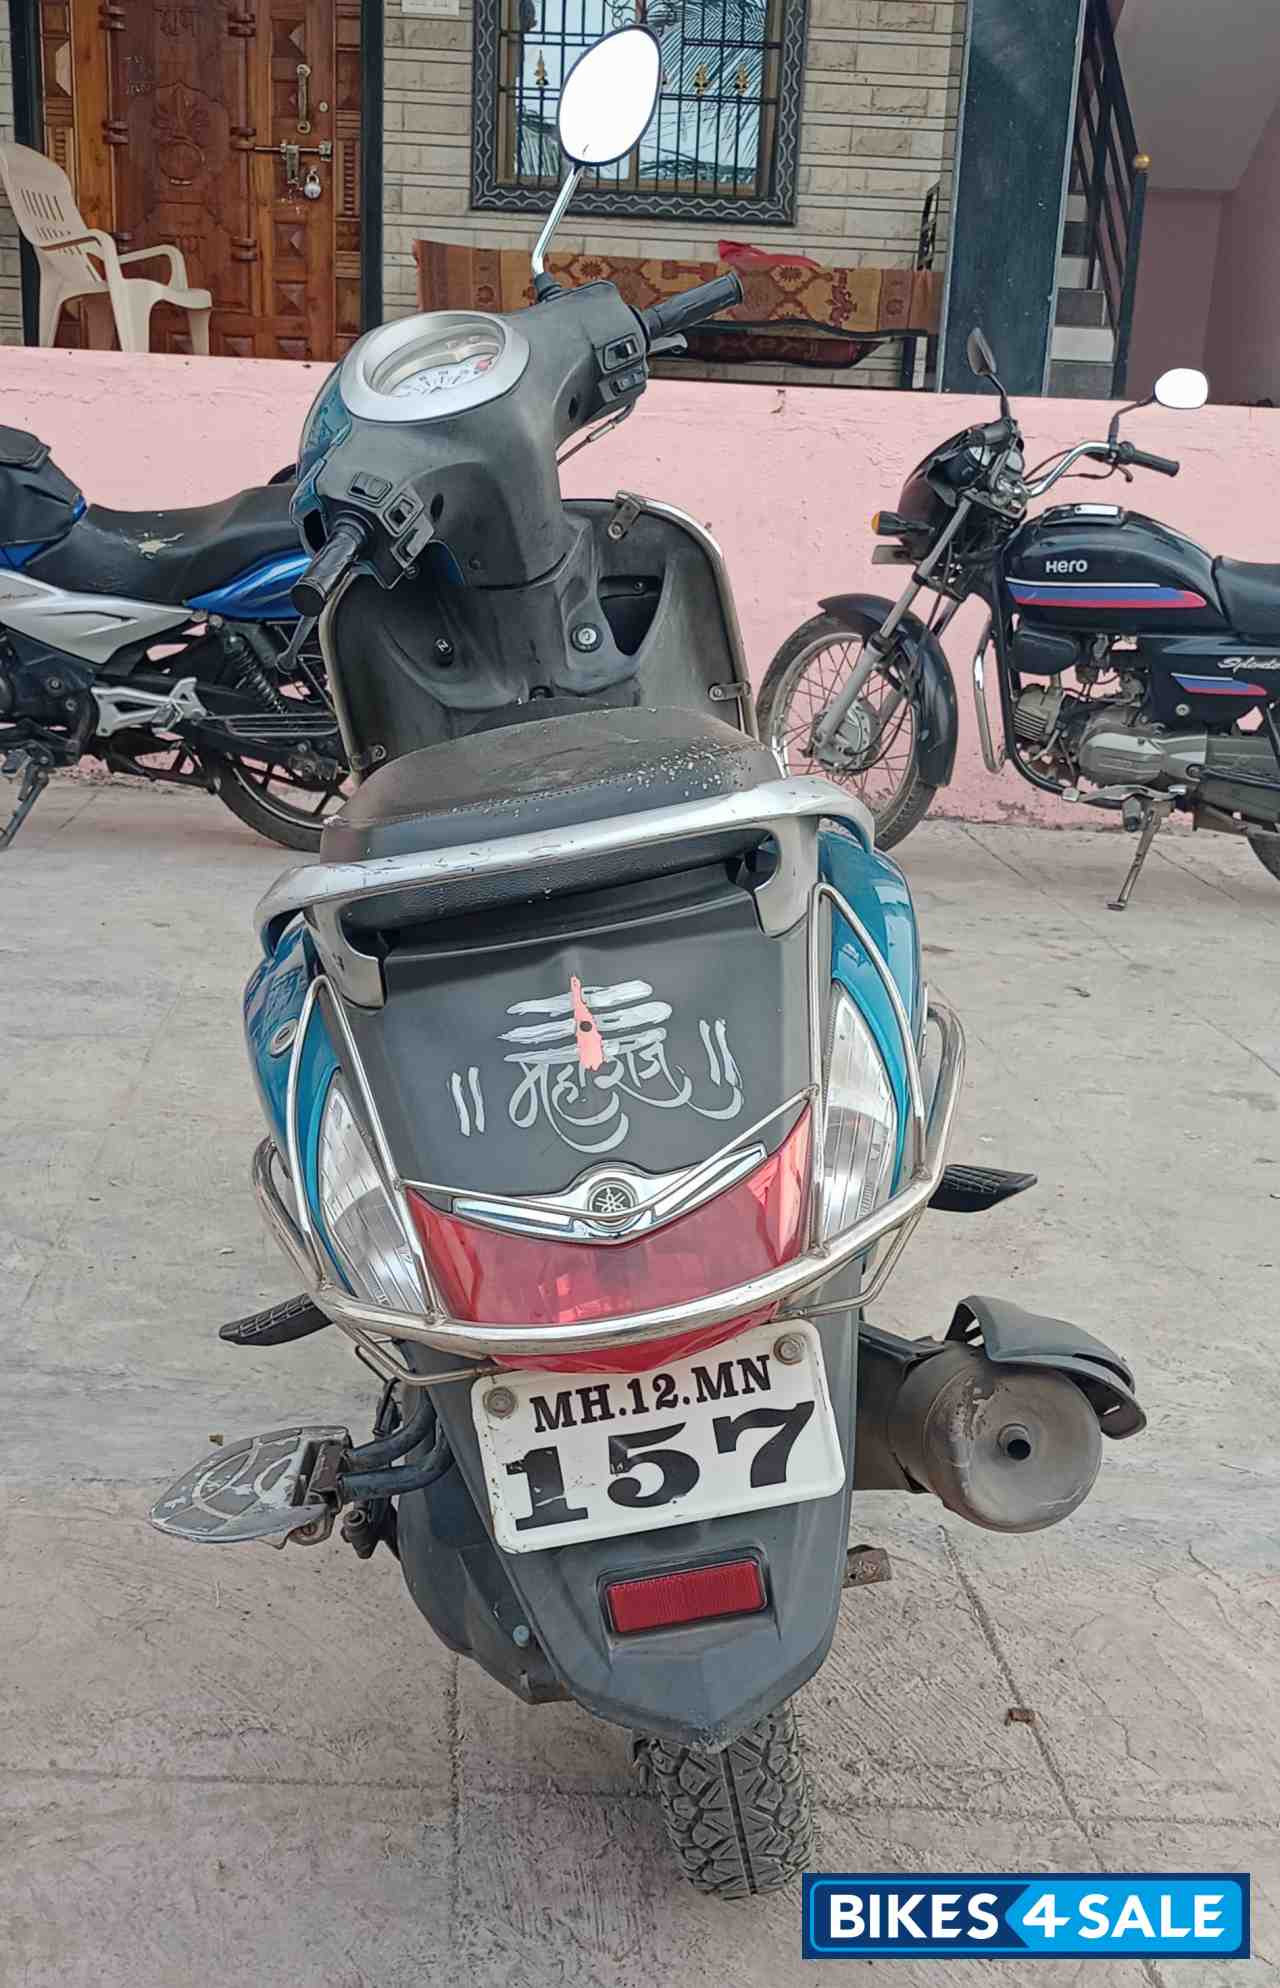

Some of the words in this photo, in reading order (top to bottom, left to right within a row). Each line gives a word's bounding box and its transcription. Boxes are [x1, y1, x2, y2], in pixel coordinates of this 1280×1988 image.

[1045, 559, 1088, 574] Hero
[529, 1354, 773, 1433] MH.12.MN
[505, 1400, 816, 1532] 157
